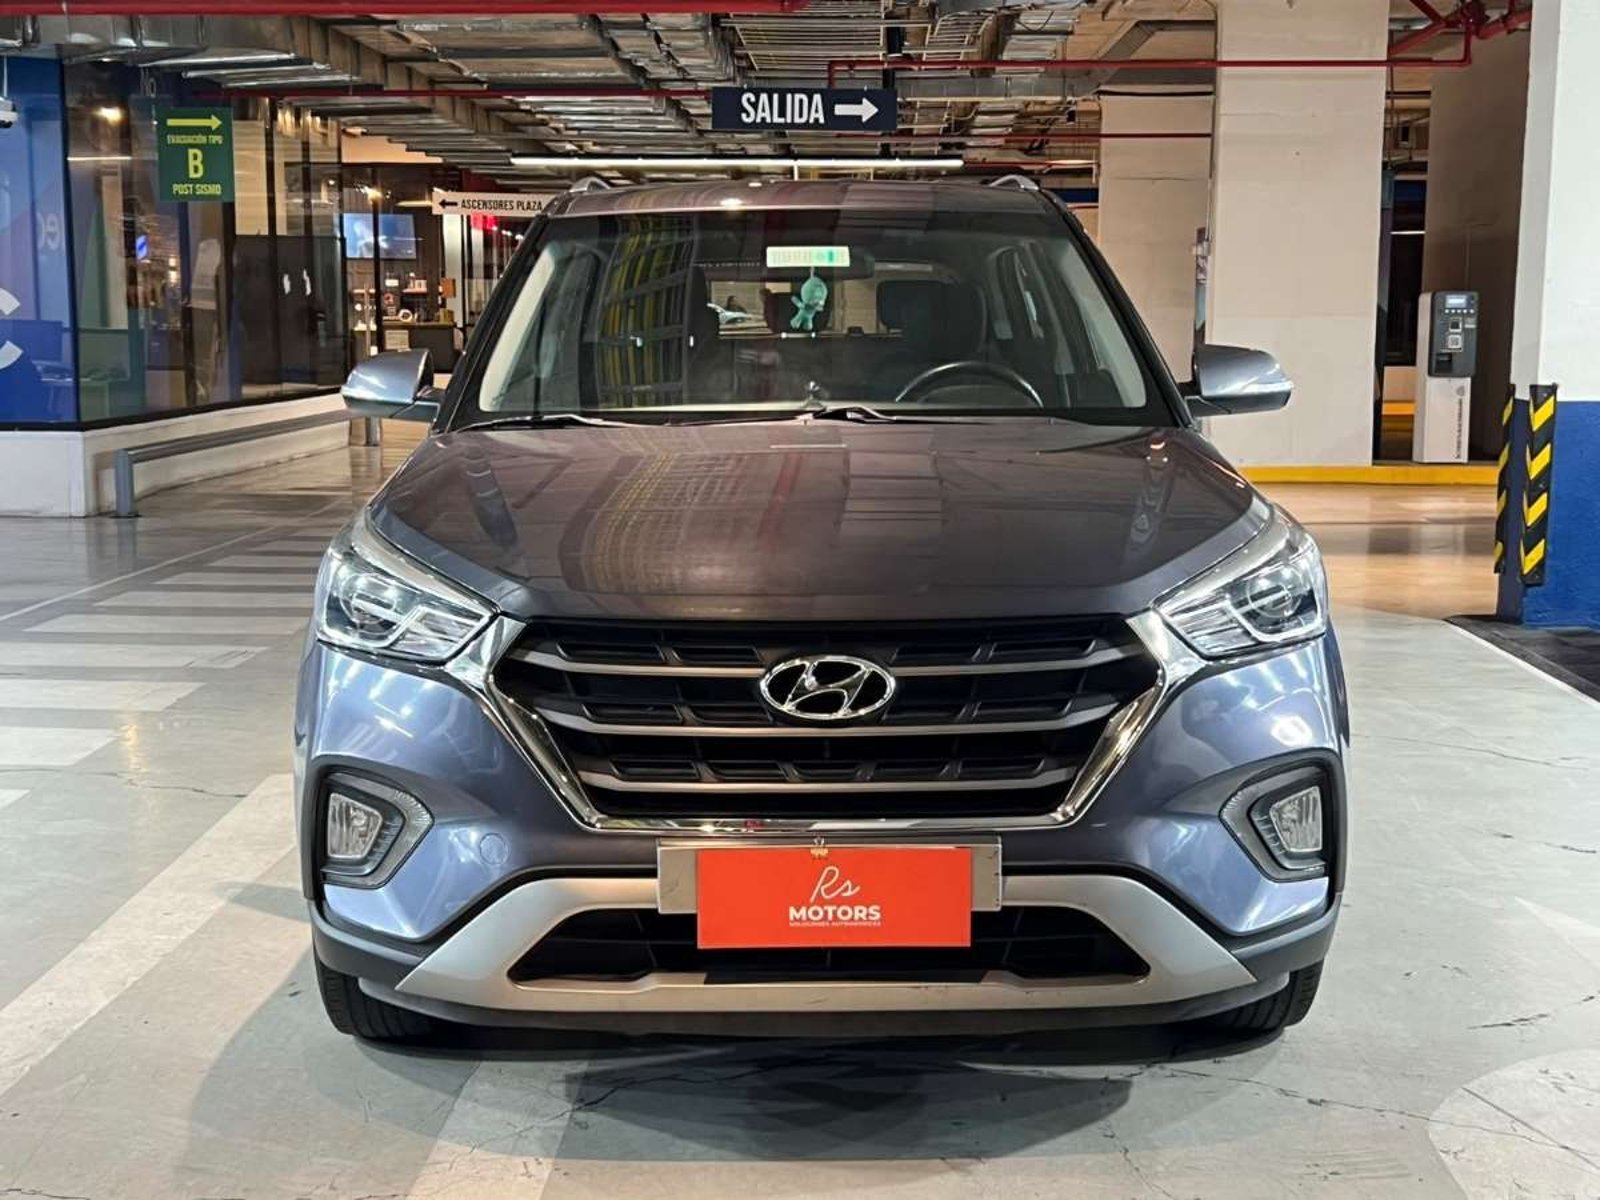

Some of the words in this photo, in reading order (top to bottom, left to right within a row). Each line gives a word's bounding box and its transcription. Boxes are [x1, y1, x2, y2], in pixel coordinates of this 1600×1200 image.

[740, 92, 825, 123] SALIDA
[187, 148, 204, 178] B
[172, 183, 193, 195] POST
[195, 183, 222, 195] SISMO
[461, 198, 515, 211] ASCENSORES
[516, 200, 543, 212] PLAZA
[789, 905, 881, 921] MOTORS
